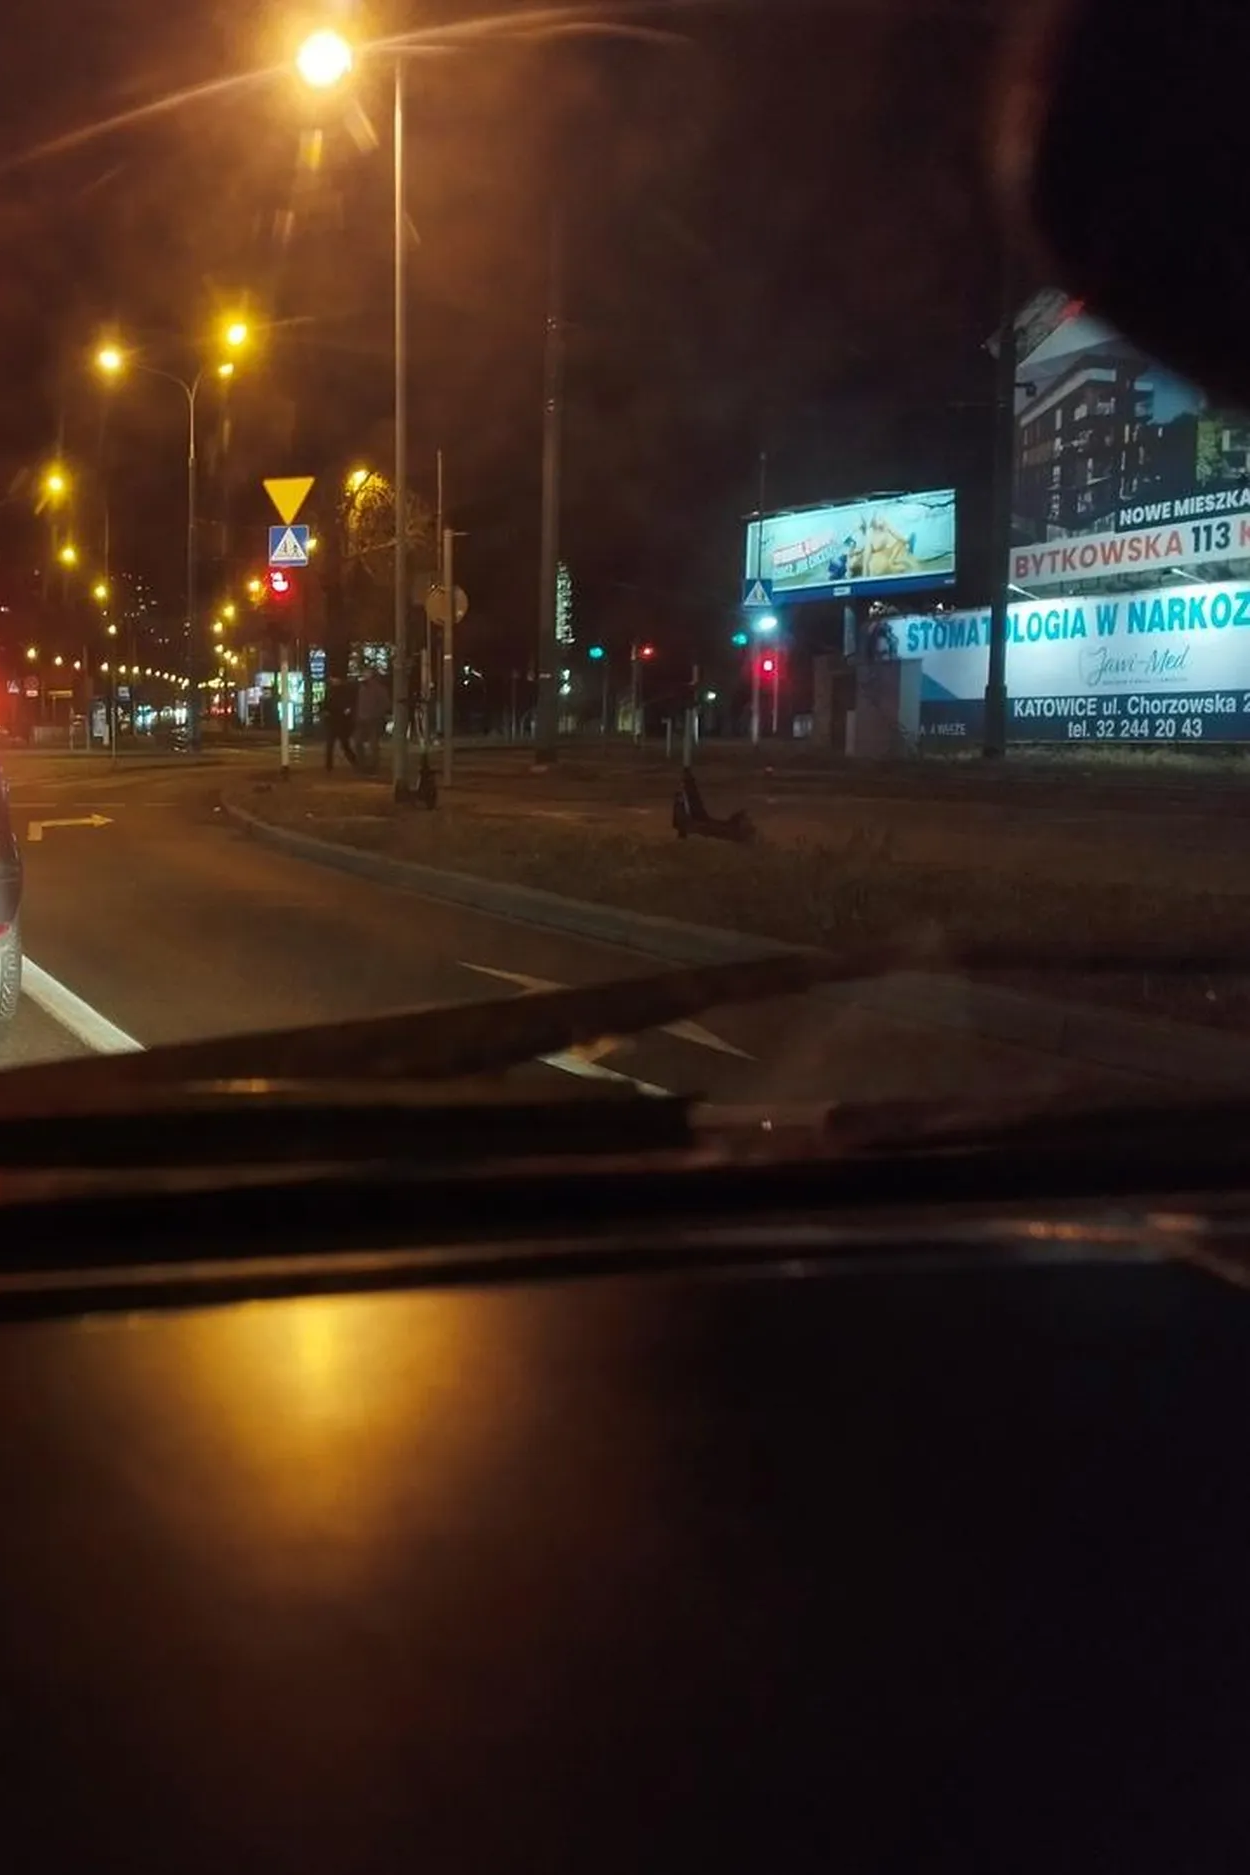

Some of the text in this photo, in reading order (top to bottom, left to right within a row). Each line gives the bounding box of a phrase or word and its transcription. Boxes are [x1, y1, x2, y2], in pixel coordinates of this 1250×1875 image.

[1119, 487, 1250, 526] NOWE MIESZKA
[1014, 530, 1183, 579] BYTKOWSKA
[1191, 521, 1232, 553] 113
[1096, 602, 1119, 637] W
[1127, 591, 1250, 635] NARKOZ
[1013, 696, 1098, 717] KATOWICE
[1102, 698, 1122, 715] ul.
[1126, 693, 1237, 715] Chorzowska
[1067, 718, 1203, 738] tel. 32 244 20 43
